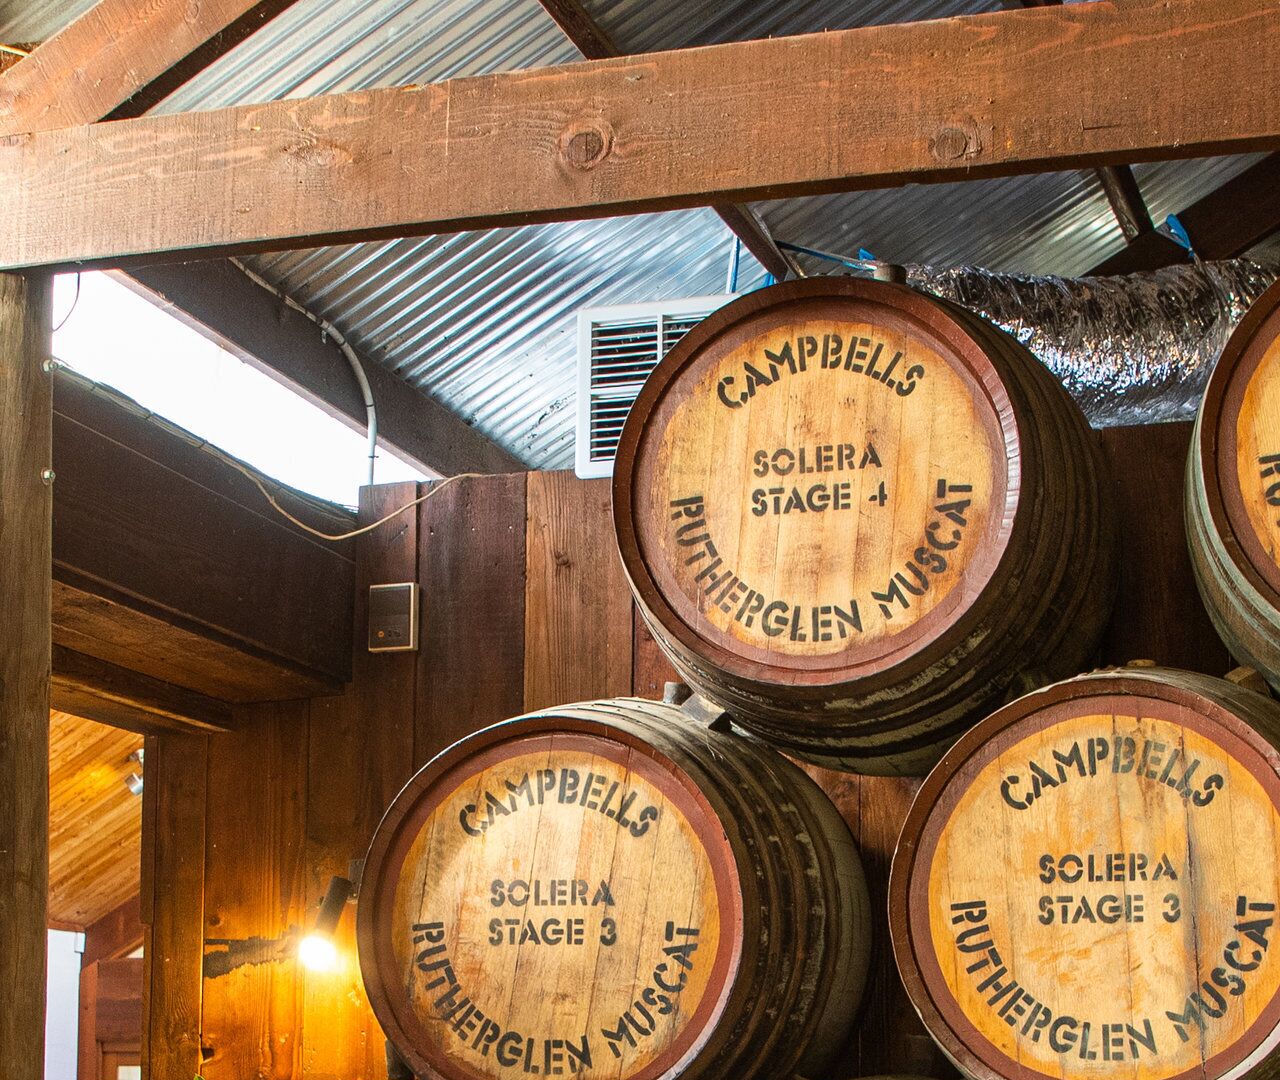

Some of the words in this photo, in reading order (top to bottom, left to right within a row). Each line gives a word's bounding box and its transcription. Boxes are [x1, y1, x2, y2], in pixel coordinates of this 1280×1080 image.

[717, 333, 925, 409] CAMPBELLS
[753, 443, 882, 478] SOLERA
[751, 482, 851, 517] STAGE
[868, 481, 888, 507] 4
[670, 495, 865, 643] RUTHERGLEN
[870, 478, 973, 619] MUSCAT
[999, 736, 1225, 811] CAMPBELLS
[459, 768, 658, 838] CAMPBELLS
[490, 879, 616, 908] SOLERA
[1038, 853, 1178, 885] SOLERA
[488, 918, 584, 947] STAGE
[599, 917, 617, 947] 3
[1038, 894, 1145, 926] STAGE
[1162, 894, 1181, 924] 3
[412, 921, 593, 1076] RUTHERGLEN
[600, 921, 700, 1058] MUSCAT
[950, 900, 1159, 1062] RUTHERGLEN
[1165, 895, 1276, 1043] MUSCAT
